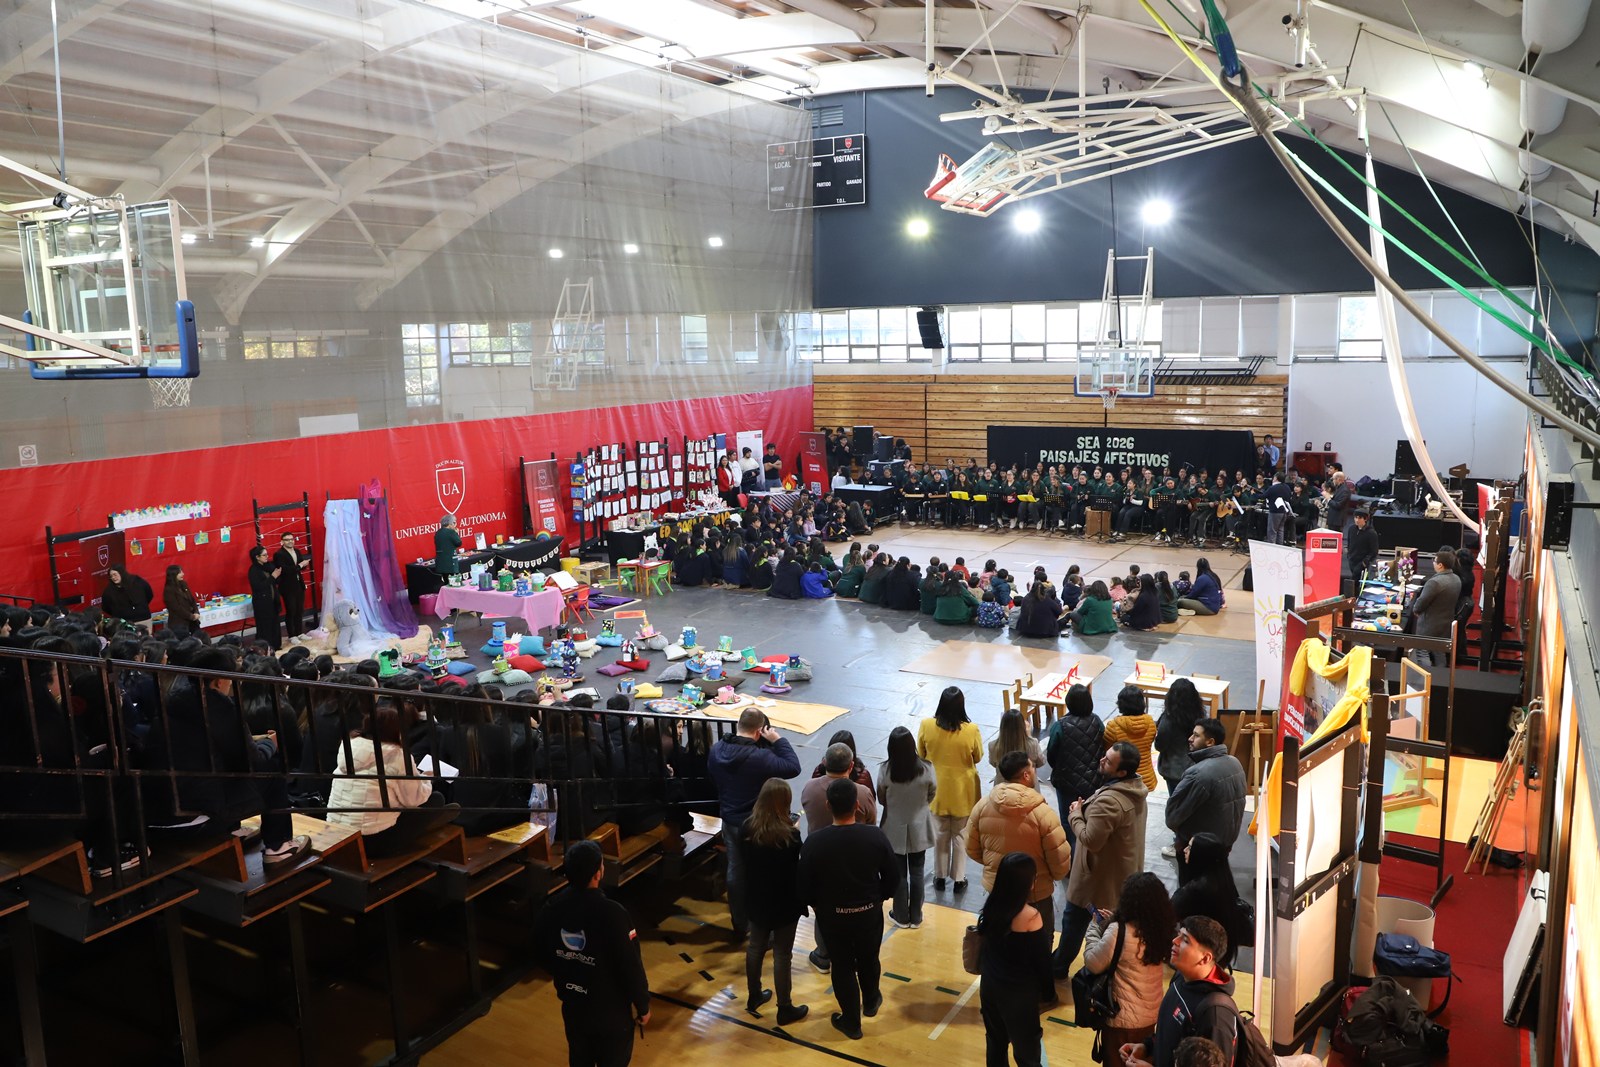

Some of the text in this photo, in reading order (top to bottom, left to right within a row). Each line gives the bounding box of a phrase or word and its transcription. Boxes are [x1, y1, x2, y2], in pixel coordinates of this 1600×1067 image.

[775, 161, 791, 169] LOCAL
[833, 154, 861, 163] VISITANTE
[1076, 436, 1135, 449] SEA 2026
[1039, 449, 1170, 467] PAISAJES AFECTIVOS
[441, 482, 460, 496] UA
[459, 511, 507, 527] AUTONOMA
[565, 983, 588, 995] CREW
